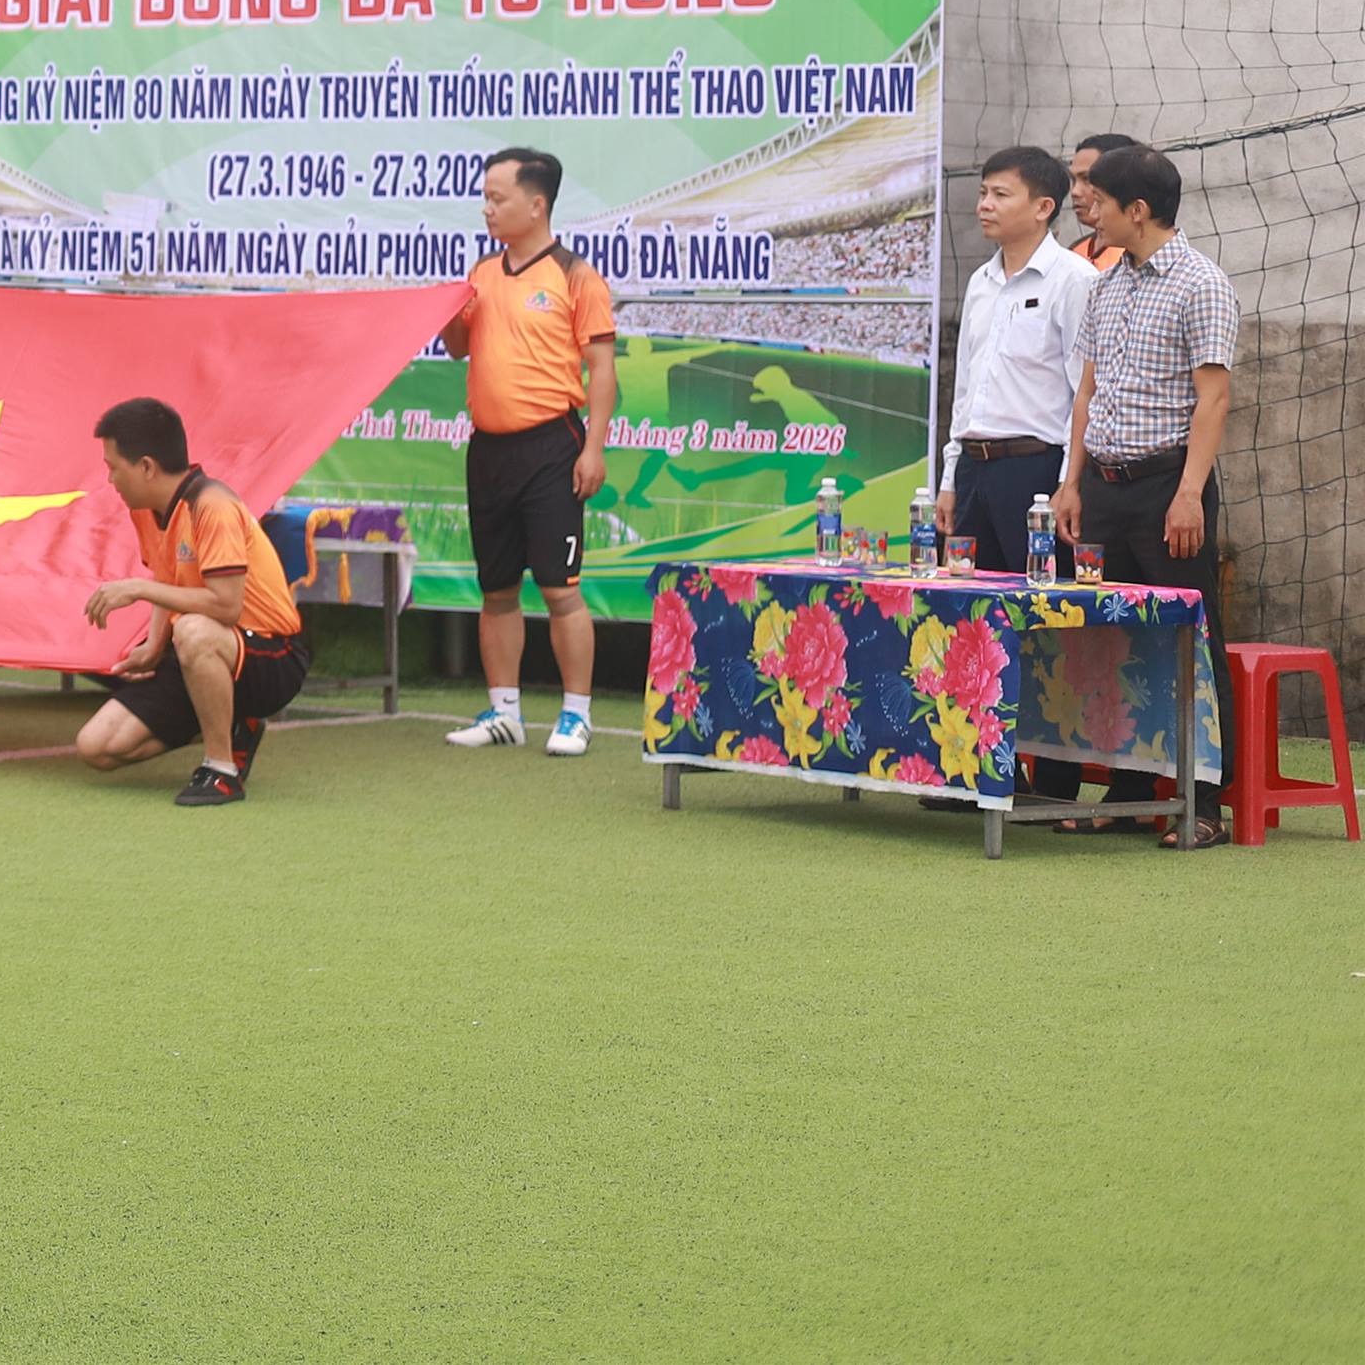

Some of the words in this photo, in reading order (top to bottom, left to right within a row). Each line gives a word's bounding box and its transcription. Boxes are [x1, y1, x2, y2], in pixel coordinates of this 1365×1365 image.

[25, 64, 57, 121] KỶ
[63, 70, 126, 131] NIỆM
[132, 78, 163, 121] 80
[170, 67, 232, 120] NĂM
[240, 66, 312, 119] NGÀY
[428, 56, 514, 118] THỐNG
[522, 61, 620, 117] NGÀNH
[629, 50, 681, 116] THỂ
[690, 68, 765, 115] THAO
[774, 57, 837, 126] VIỆT
[844, 66, 915, 116] NAM
[209, 154, 346, 201] (27.3.1946
[371, 154, 486, 197] 27.3.202
[59, 221, 122, 282] NIỆM
[129, 230, 157, 273] 51
[168, 222, 227, 274] NĂM
[235, 222, 307, 275] NGÀY
[316, 216, 368, 276] GIẢI
[376, 222, 466, 278] PHÓNG
[639, 224, 679, 280] ĐÀ
[689, 217, 771, 281] NẴNG
[402, 408, 473, 450] Thuậ
[690, 419, 712, 451] 3
[712, 420, 777, 452] năm
[783, 422, 847, 455] 2026
[565, 535, 578, 567] 7
